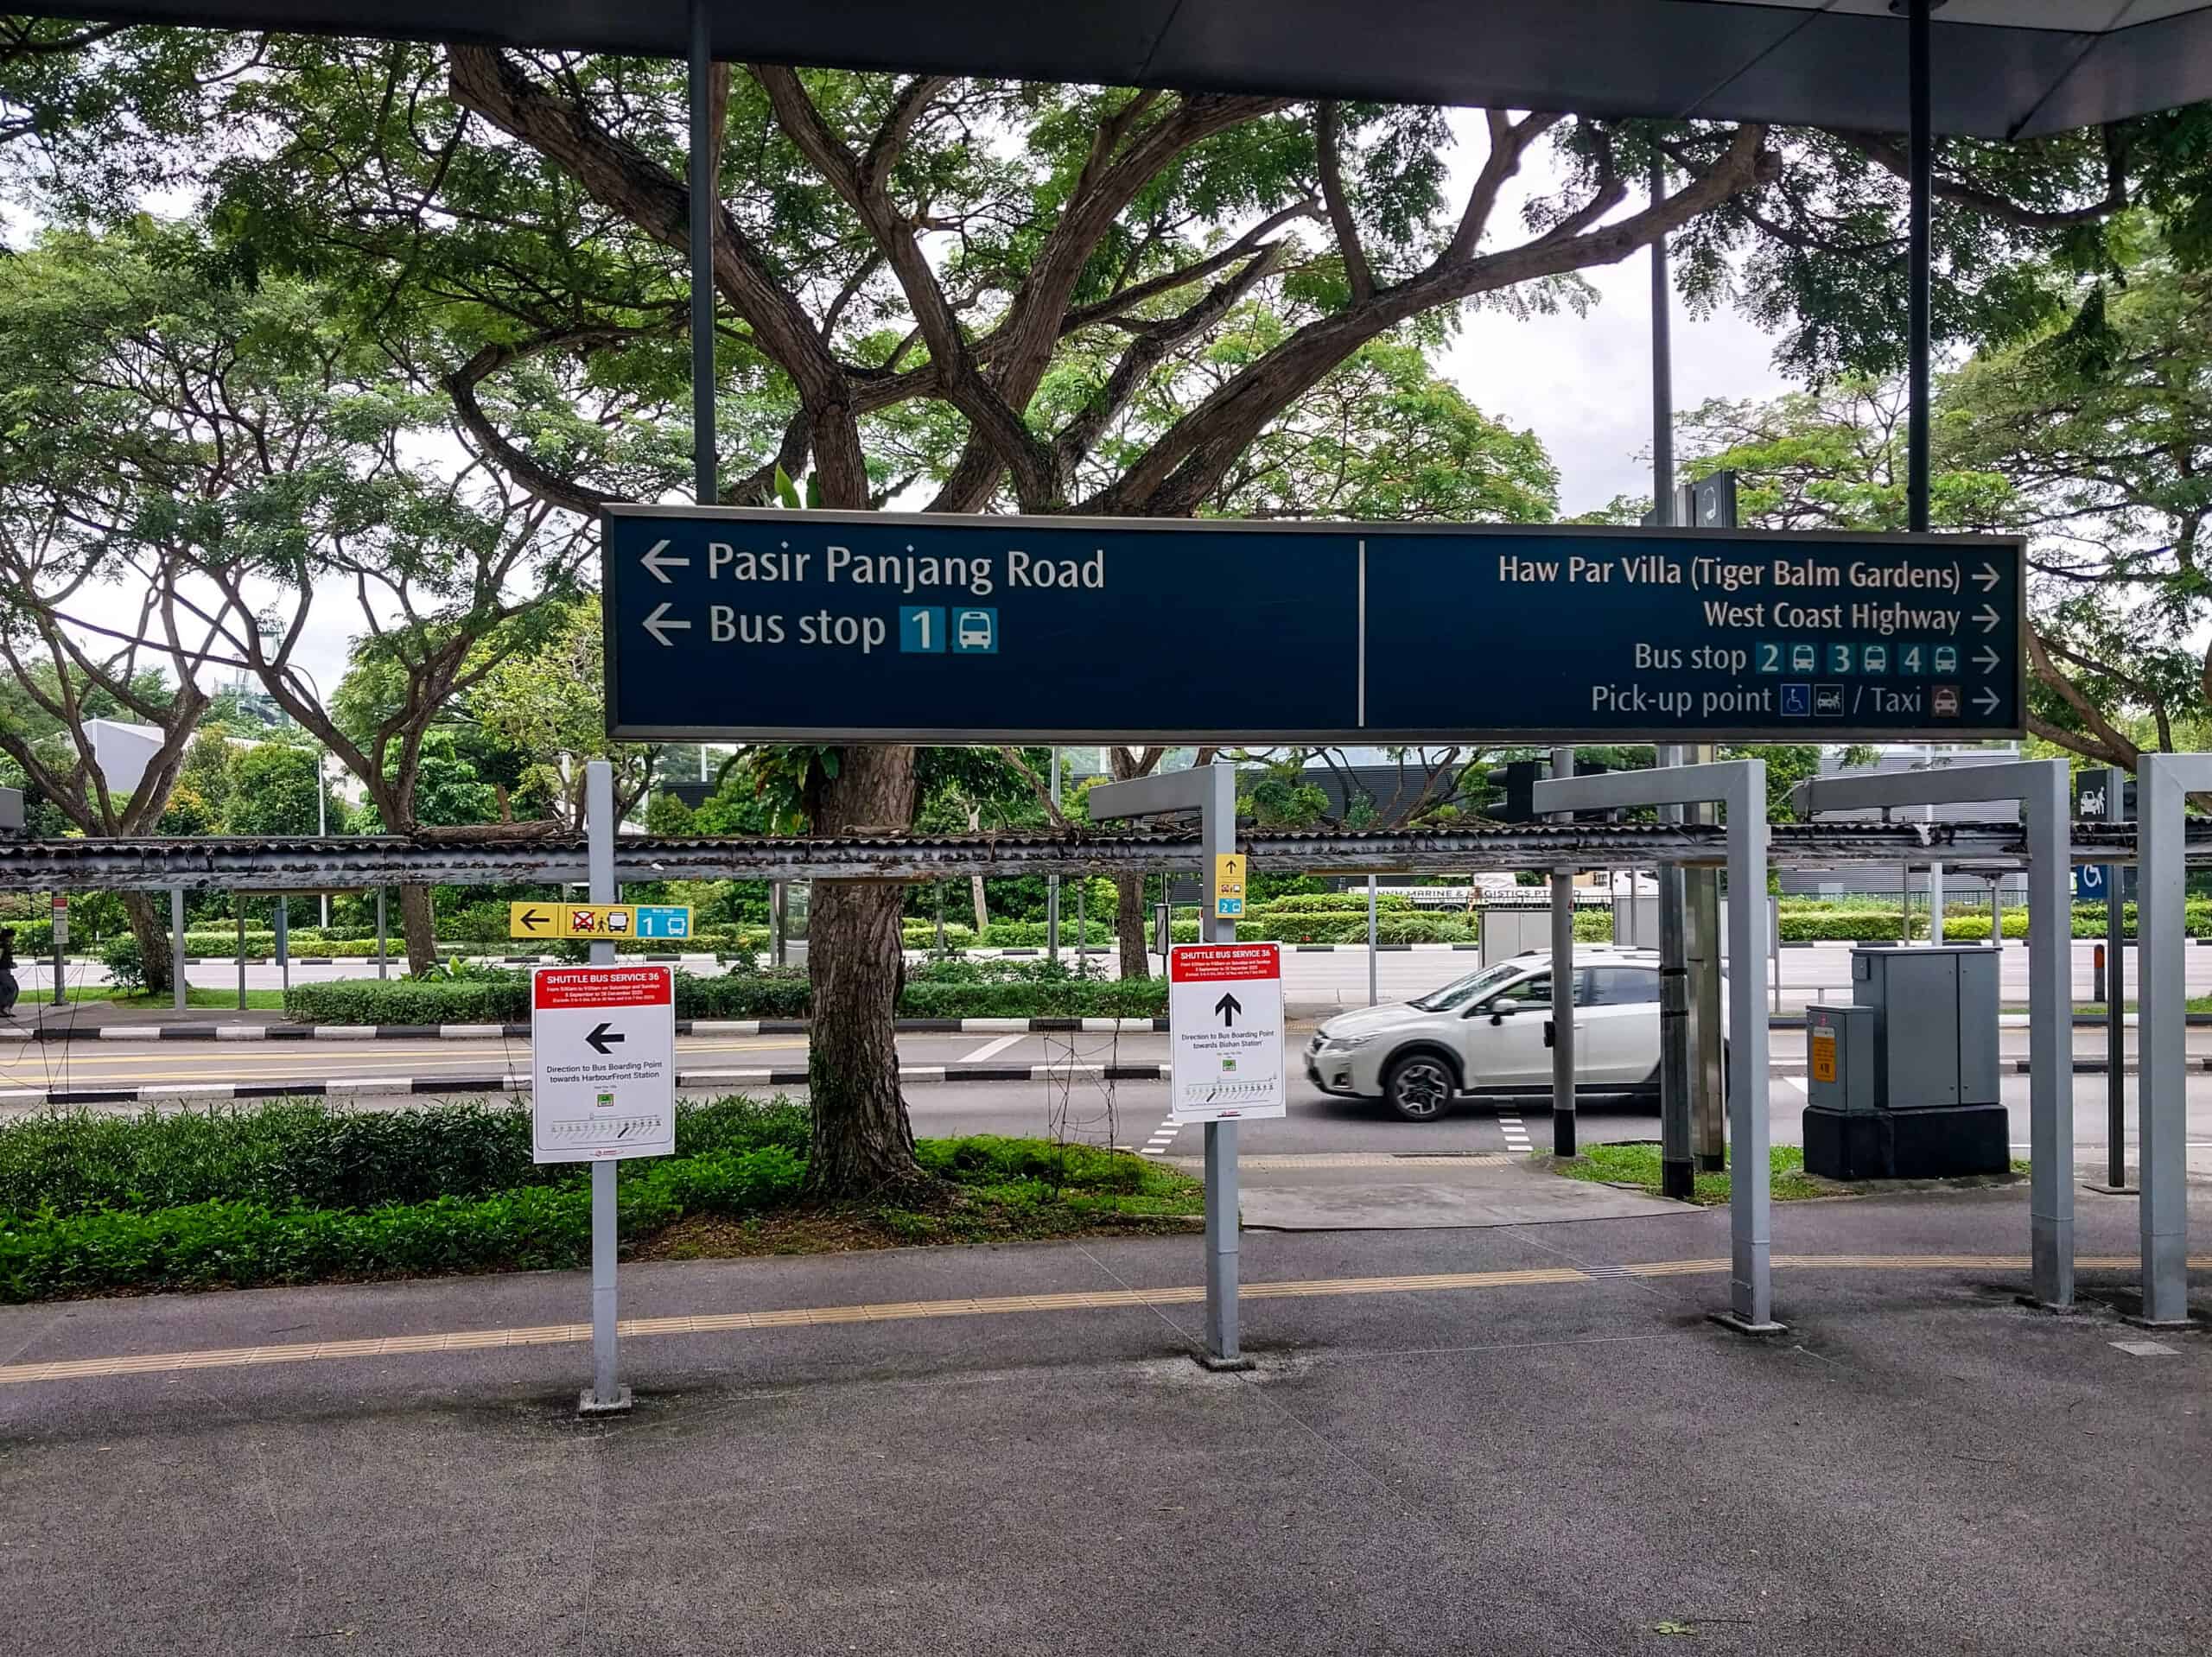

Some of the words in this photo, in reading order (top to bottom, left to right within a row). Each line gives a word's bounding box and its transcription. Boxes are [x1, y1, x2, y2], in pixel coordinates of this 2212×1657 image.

[709, 542, 810, 581] Pasir
[828, 545, 992, 594] Panjang
[1009, 550, 1103, 587] Road
[1500, 556, 1559, 581] Haw
[1570, 557, 1613, 582] Par
[1622, 556, 1681, 583] Villa
[1692, 556, 1764, 591] (Tiger
[1775, 559, 1839, 586] Balm
[1850, 561, 1959, 594] Gardens)
[711, 606, 784, 643] Bus
[799, 610, 885, 653] stop
[912, 611, 930, 648] 1
[1704, 601, 1764, 626] West
[1774, 602, 1841, 627] Coast
[1853, 602, 1960, 635] Highway
[1636, 644, 1681, 668] Bus
[1692, 645, 1745, 675] stop
[1762, 644, 1778, 670] 2
[1835, 645, 1850, 671] 3
[1904, 647, 1920, 672] 4
[1593, 684, 1691, 717] Pick-up
[1704, 685, 1770, 717] point
[1871, 686, 1920, 712] Taxi
[1221, 903, 1229, 913] 2
[643, 917, 652, 936] 1
[1180, 951, 1216, 960] SHUTTLE
[1232, 949, 1260, 958] SERVICE
[547, 975, 588, 984] SHUTTLE
[590, 974, 608, 983] BUS
[610, 973, 646, 982] SERVICE
[649, 973, 659, 981] 36
[547, 1064, 581, 1073] Direction
[592, 1063, 607, 1072] Bus
[608, 1062, 642, 1071] Boarding
[644, 1060, 663, 1069] Point
[550, 1075, 581, 1083] towards
[582, 1072, 632, 1082] HarbourFront
